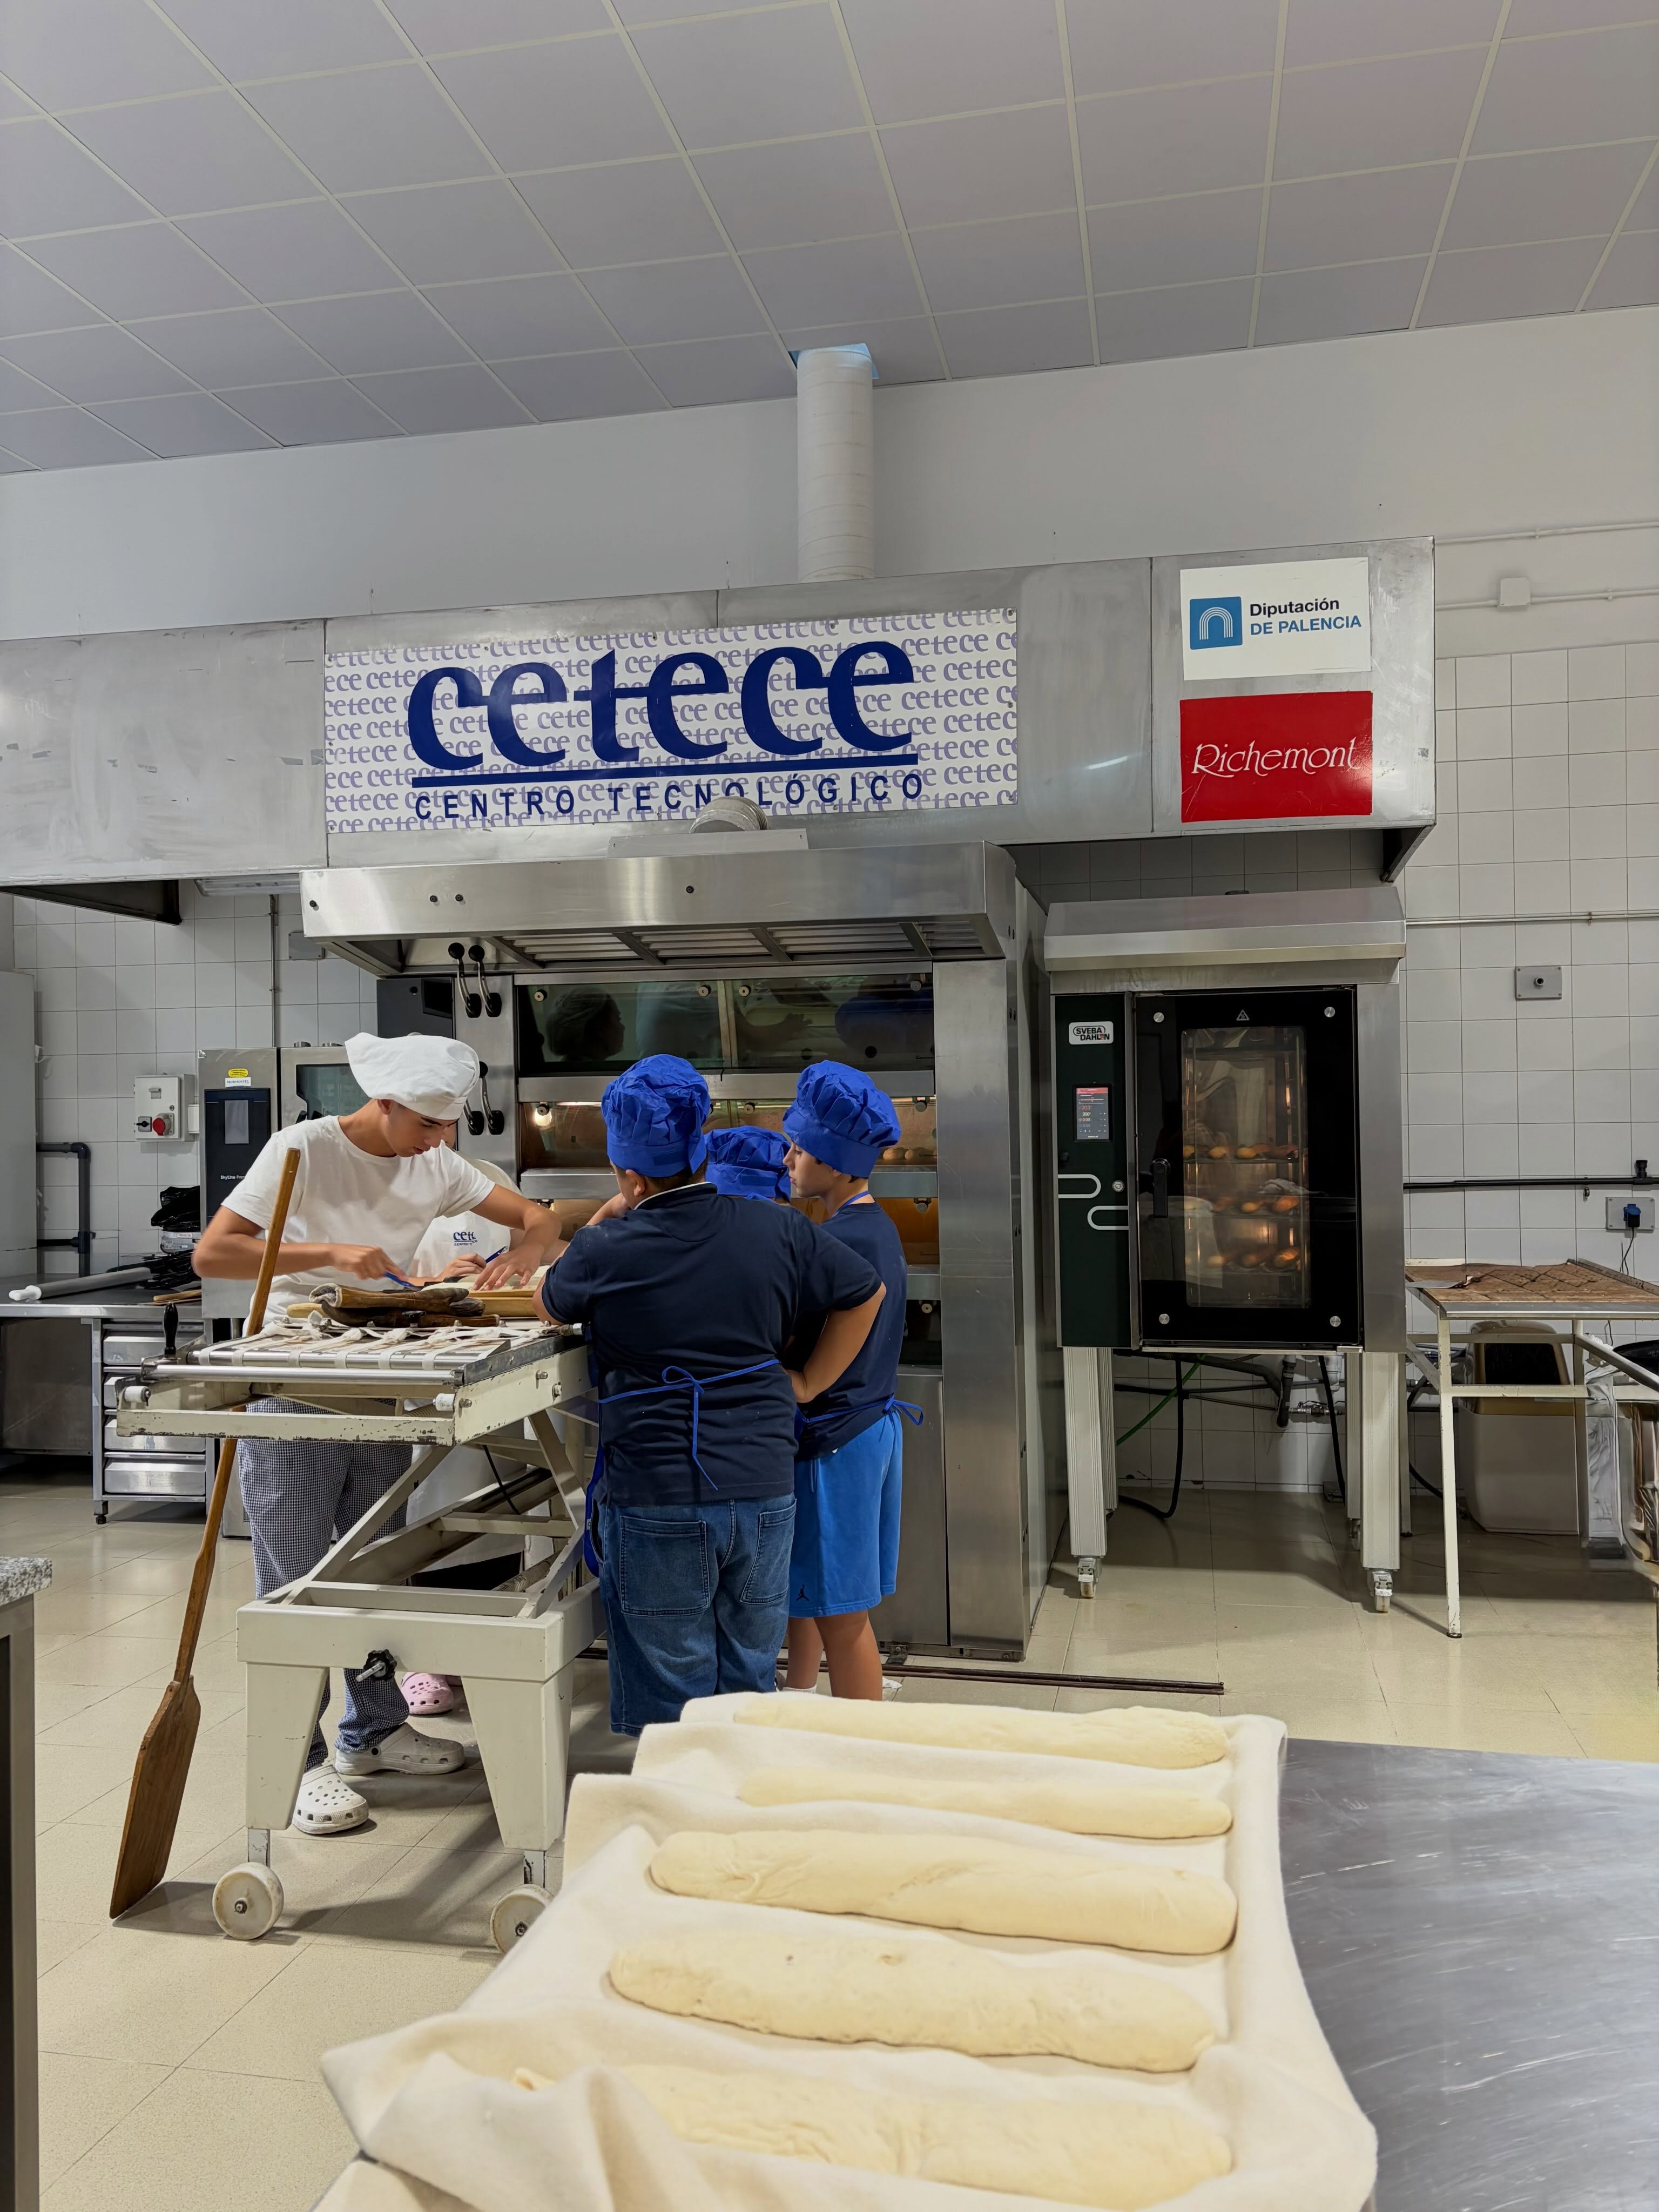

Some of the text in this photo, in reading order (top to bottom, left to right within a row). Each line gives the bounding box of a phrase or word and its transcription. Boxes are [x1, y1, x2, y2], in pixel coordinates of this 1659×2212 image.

[1250, 598, 1339, 618] Diputación
[1250, 615, 1362, 636] DE PALENCIA
[901, 633, 989, 657] cetece
[408, 640, 914, 771] cetece
[901, 687, 989, 710] cetece
[1191, 736, 1360, 778] Richemont
[415, 789, 575, 820] CENTRO
